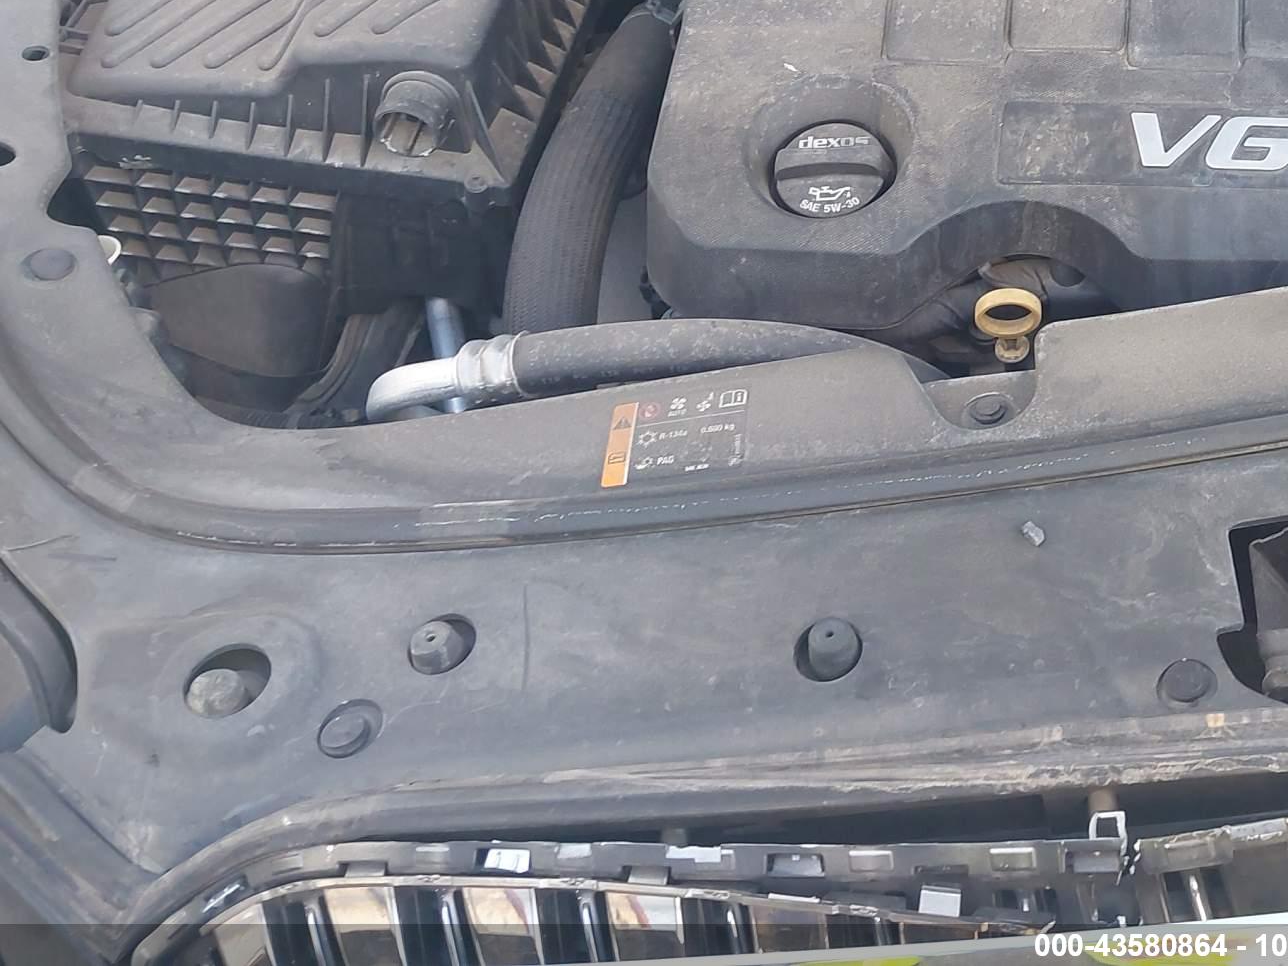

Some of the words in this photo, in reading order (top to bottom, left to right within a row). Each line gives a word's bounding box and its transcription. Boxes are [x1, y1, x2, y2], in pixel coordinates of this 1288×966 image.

[798, 136, 871, 149] dexos
[800, 199, 821, 213] SAE
[823, 196, 860, 214] 5W-30
